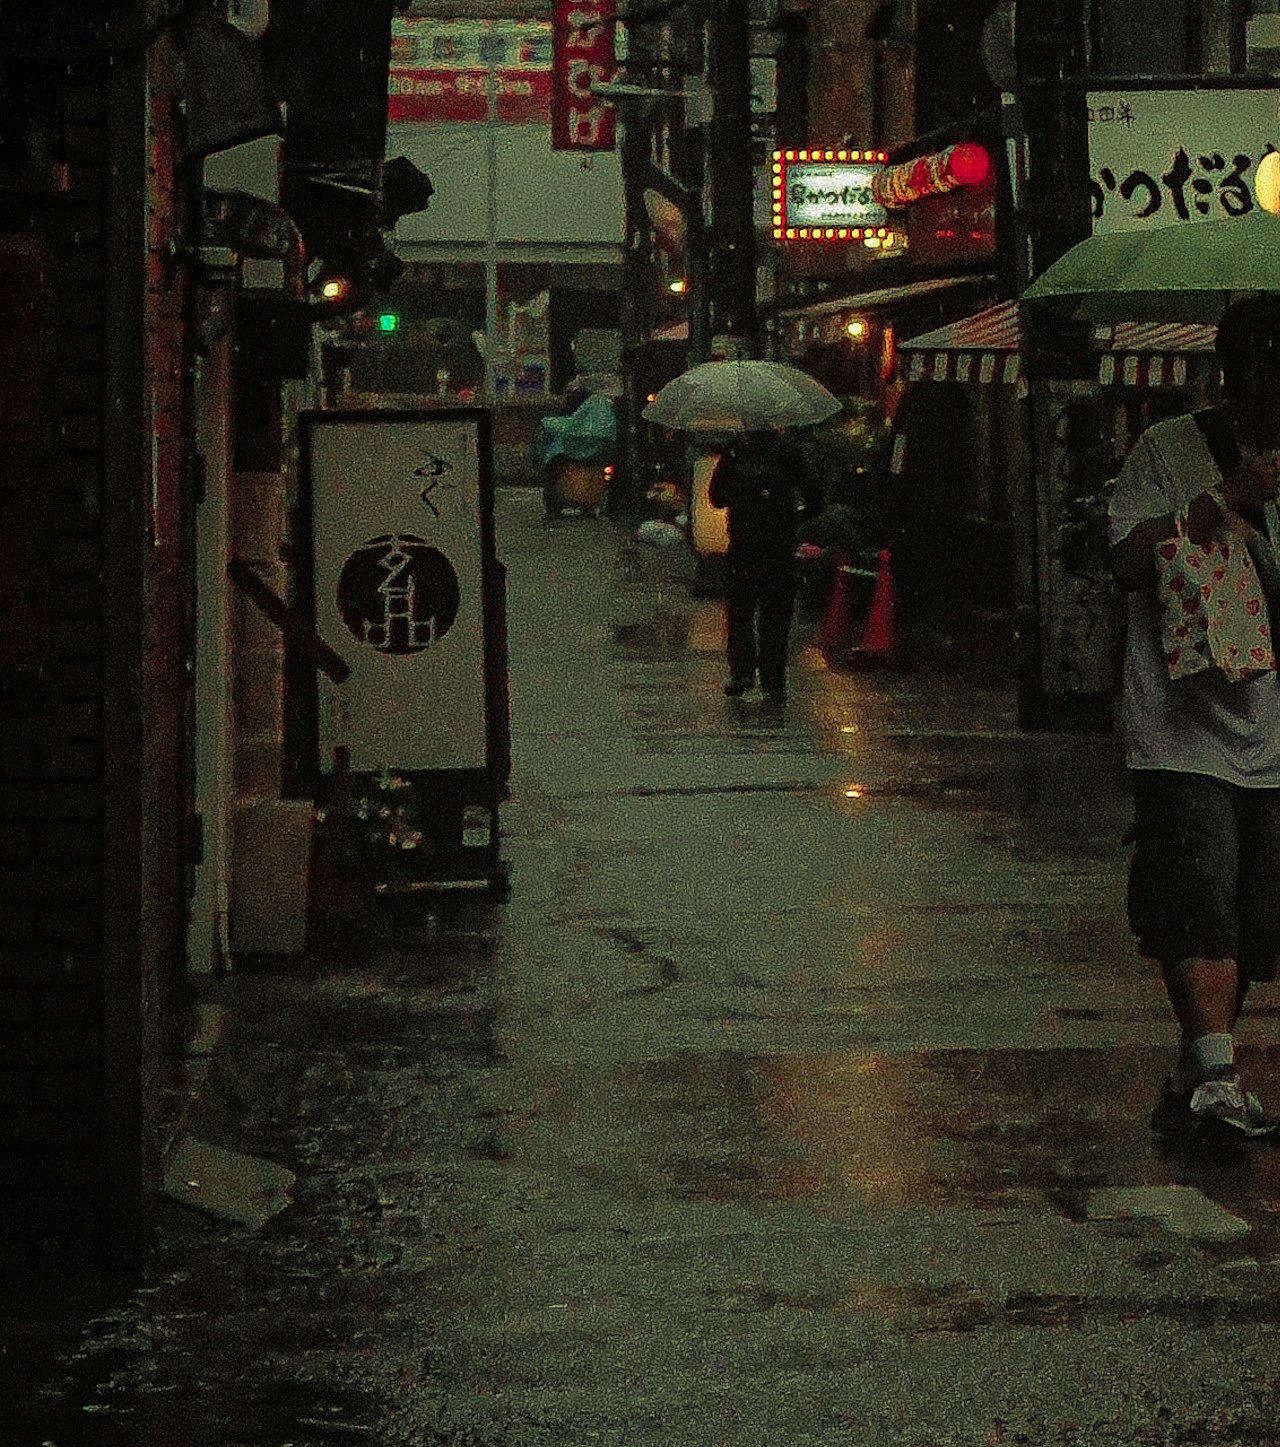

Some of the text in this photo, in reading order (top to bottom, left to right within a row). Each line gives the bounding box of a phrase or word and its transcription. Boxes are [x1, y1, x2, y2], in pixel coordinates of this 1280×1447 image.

[791, 182, 874, 209] 串かつだる
